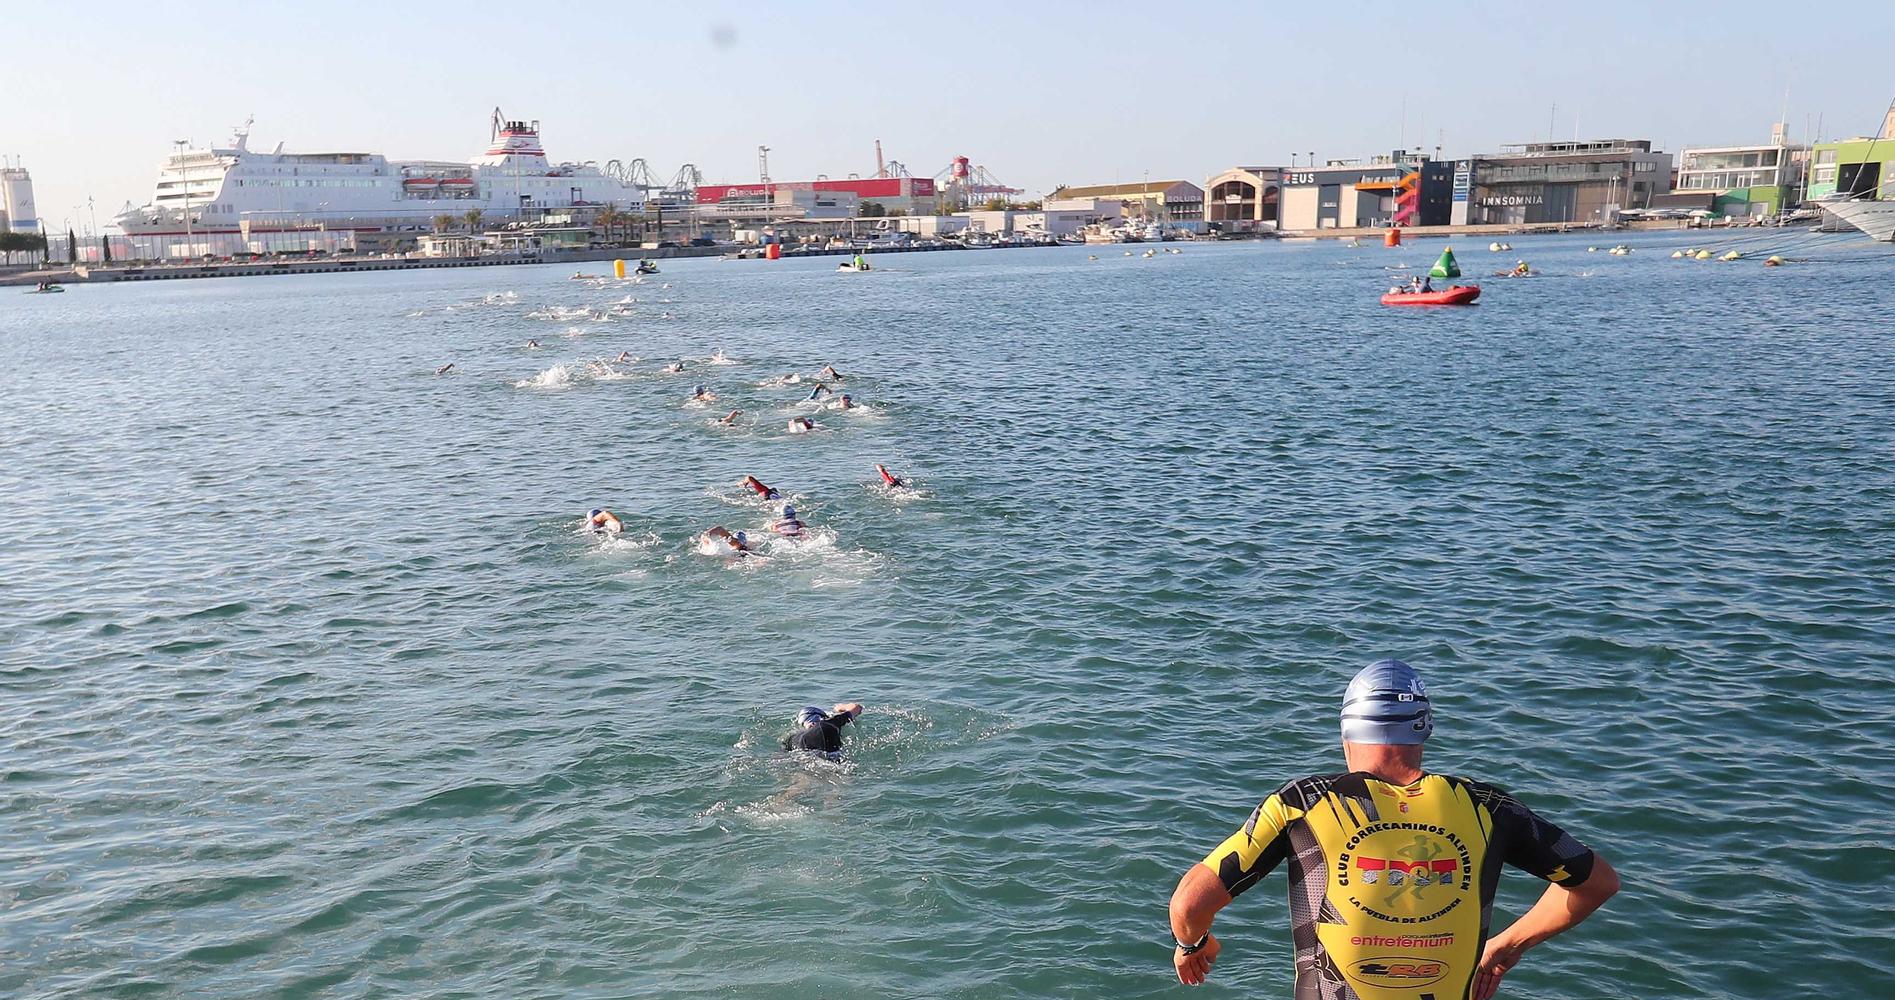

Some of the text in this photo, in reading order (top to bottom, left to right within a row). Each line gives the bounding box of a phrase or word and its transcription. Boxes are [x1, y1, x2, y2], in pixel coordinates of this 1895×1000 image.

[1483, 196, 1543, 206] INNSOMNIA
[1338, 823, 1471, 891] CLUB CORRECAMINOS ALFINDEN
[1349, 896, 1361, 908] LA
[1361, 905, 1399, 923] PUEBLA
[1418, 898, 1462, 923] ALFINDEN
[1351, 935, 1454, 948] entretenium
